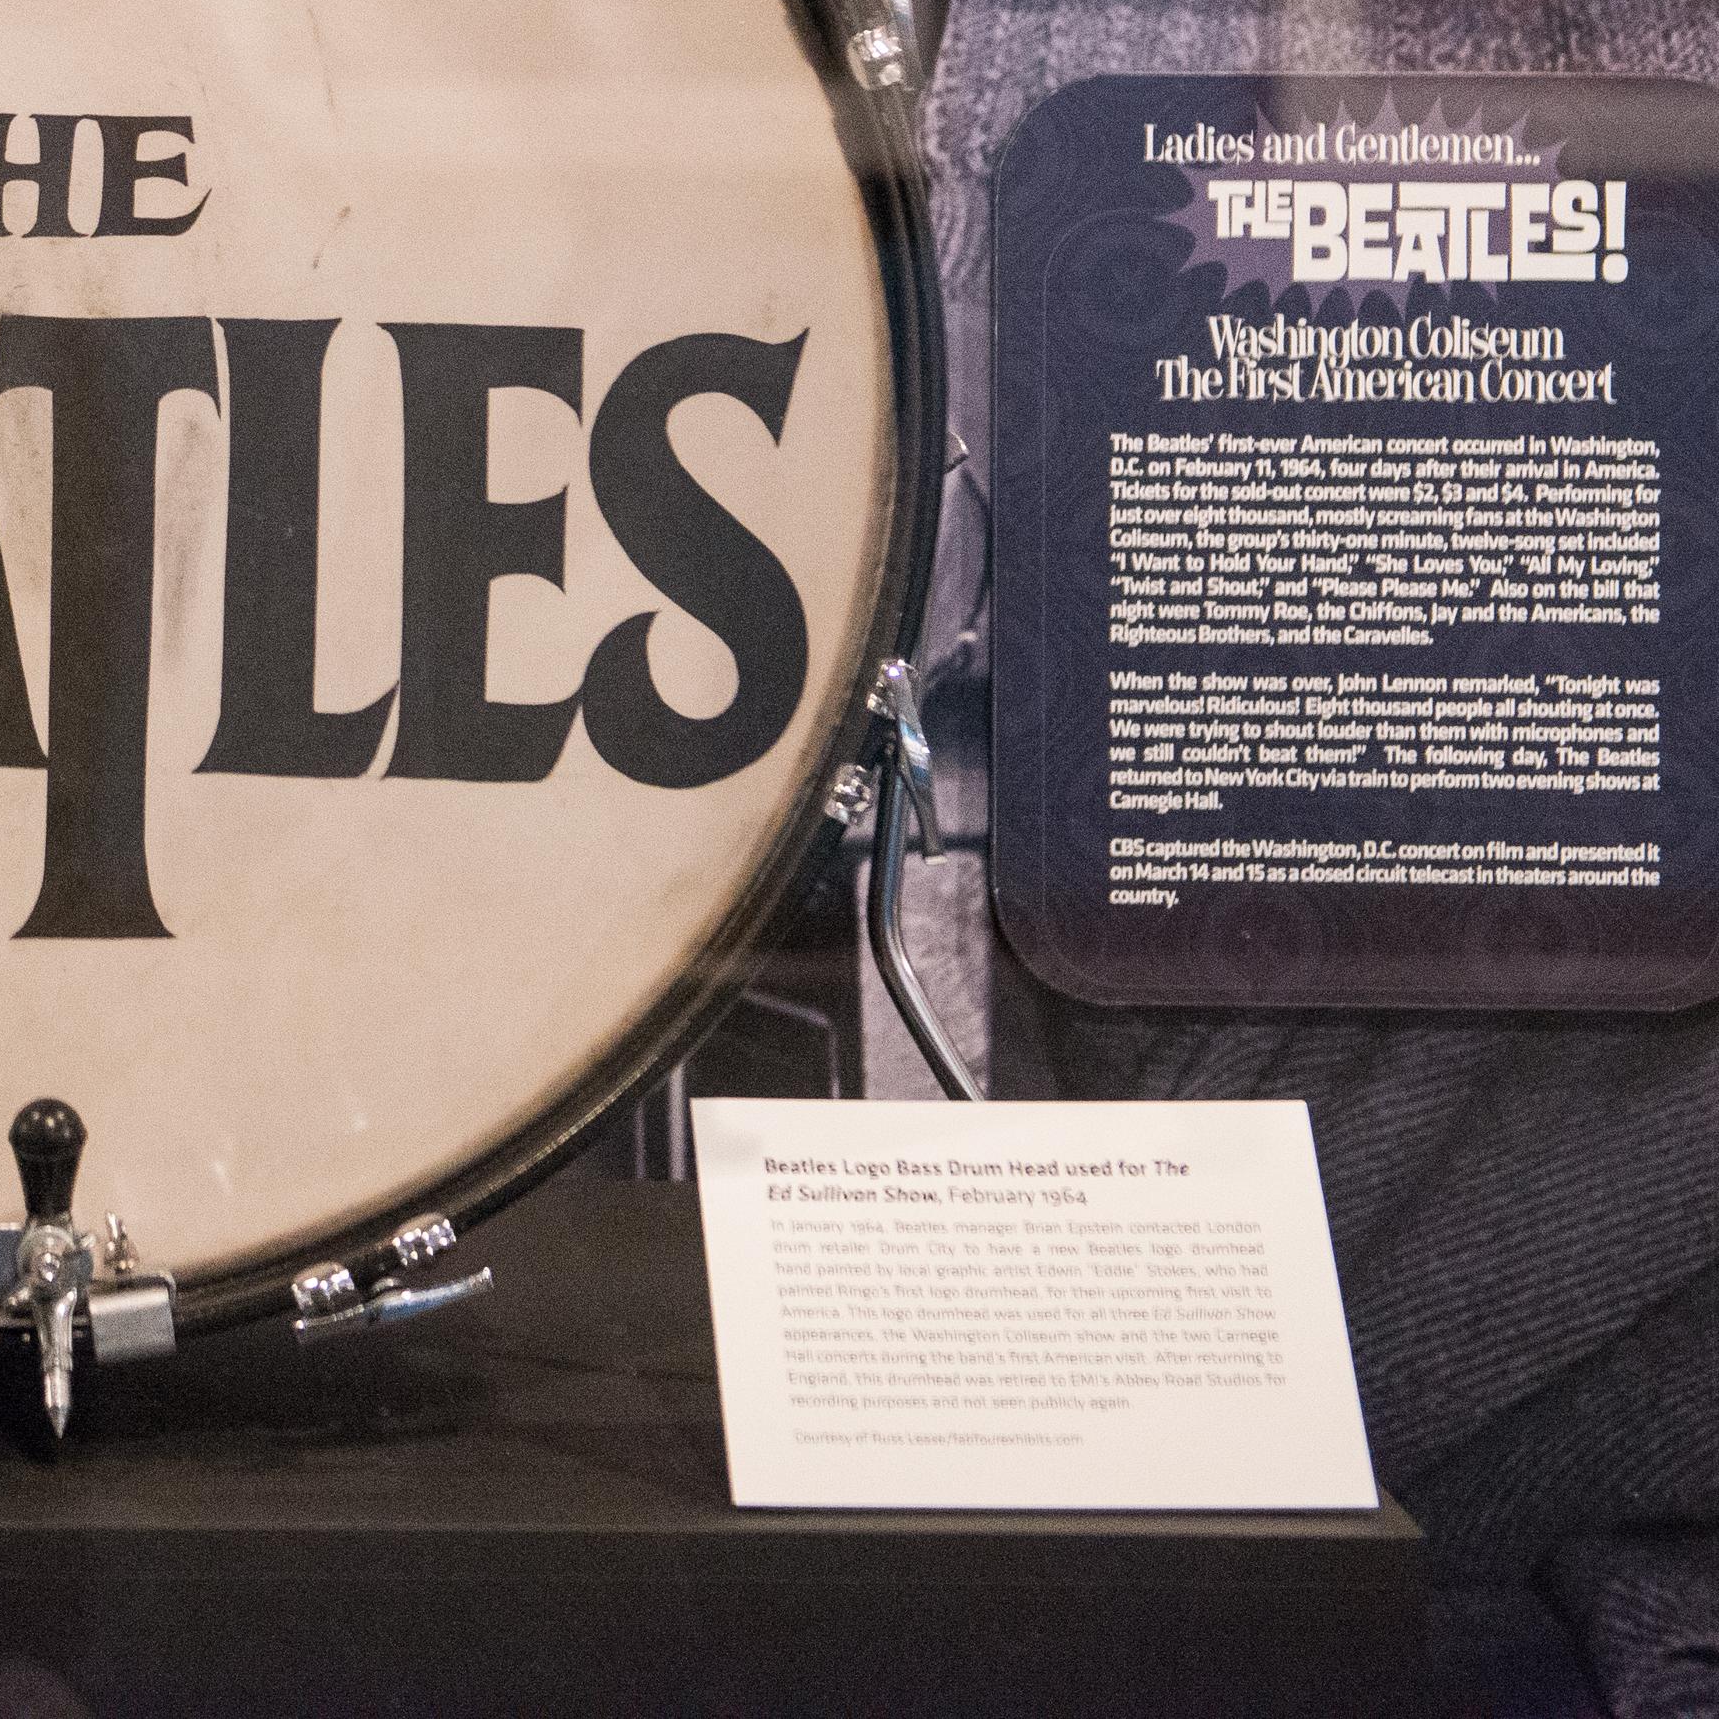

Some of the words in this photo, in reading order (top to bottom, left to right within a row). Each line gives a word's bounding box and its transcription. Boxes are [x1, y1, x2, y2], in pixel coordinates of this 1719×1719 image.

[1144, 122, 1255, 165] Ladies
[1262, 123, 1326, 165] and
[1334, 123, 1541, 166] Gentlemen...
[1208, 179, 1293, 240] THE
[1291, 179, 1629, 283] BEATLES!
[1208, 313, 1404, 361] Washington
[1405, 311, 1565, 360] Coliseum
[1155, 358, 1224, 402] The
[1228, 359, 1304, 402] First
[1309, 360, 1475, 403] American
[1479, 361, 1616, 404] Concert
[1111, 434, 1143, 452] The
[1148, 433, 1213, 453] Beatles'
[1218, 434, 1297, 453] first-ever
[1301, 435, 1382, 453] American
[1387, 437, 1448, 454] concert
[1452, 436, 1524, 454] occurred
[1529, 436, 1546, 454] in
[1551, 436, 1660, 459] Washington,
[1111, 458, 1143, 476] D.C.
[1148, 462, 1171, 476] on
[1175, 458, 1251, 479] February
[1256, 459, 1276, 478] 11,
[1281, 459, 1326, 478] 1964,
[1330, 458, 1367, 477] four
[1370, 459, 1411, 480] days
[1416, 459, 1457, 479] after
[1460, 459, 1501, 478] their
[1506, 460, 1558, 479] arrival
[1563, 460, 1580, 478] in
[1585, 460, 1660, 479] America.
[763, 1157, 837, 1175] Beatles
[842, 1160, 891, 1180] Logo
[896, 1159, 942, 1176] Bass
[947, 1159, 1003, 1177] Drum
[1008, 1160, 1060, 1177] Head
[1065, 1160, 1113, 1177] used
[1117, 1159, 1146, 1176] for
[1153, 1159, 1190, 1177] The
[767, 1184, 793, 1202] Ed
[797, 1184, 878, 1202] Sullivan
[883, 1184, 942, 1203] Show,
[948, 1186, 1034, 1205] February
[1040, 1187, 1088, 1206] 1964
